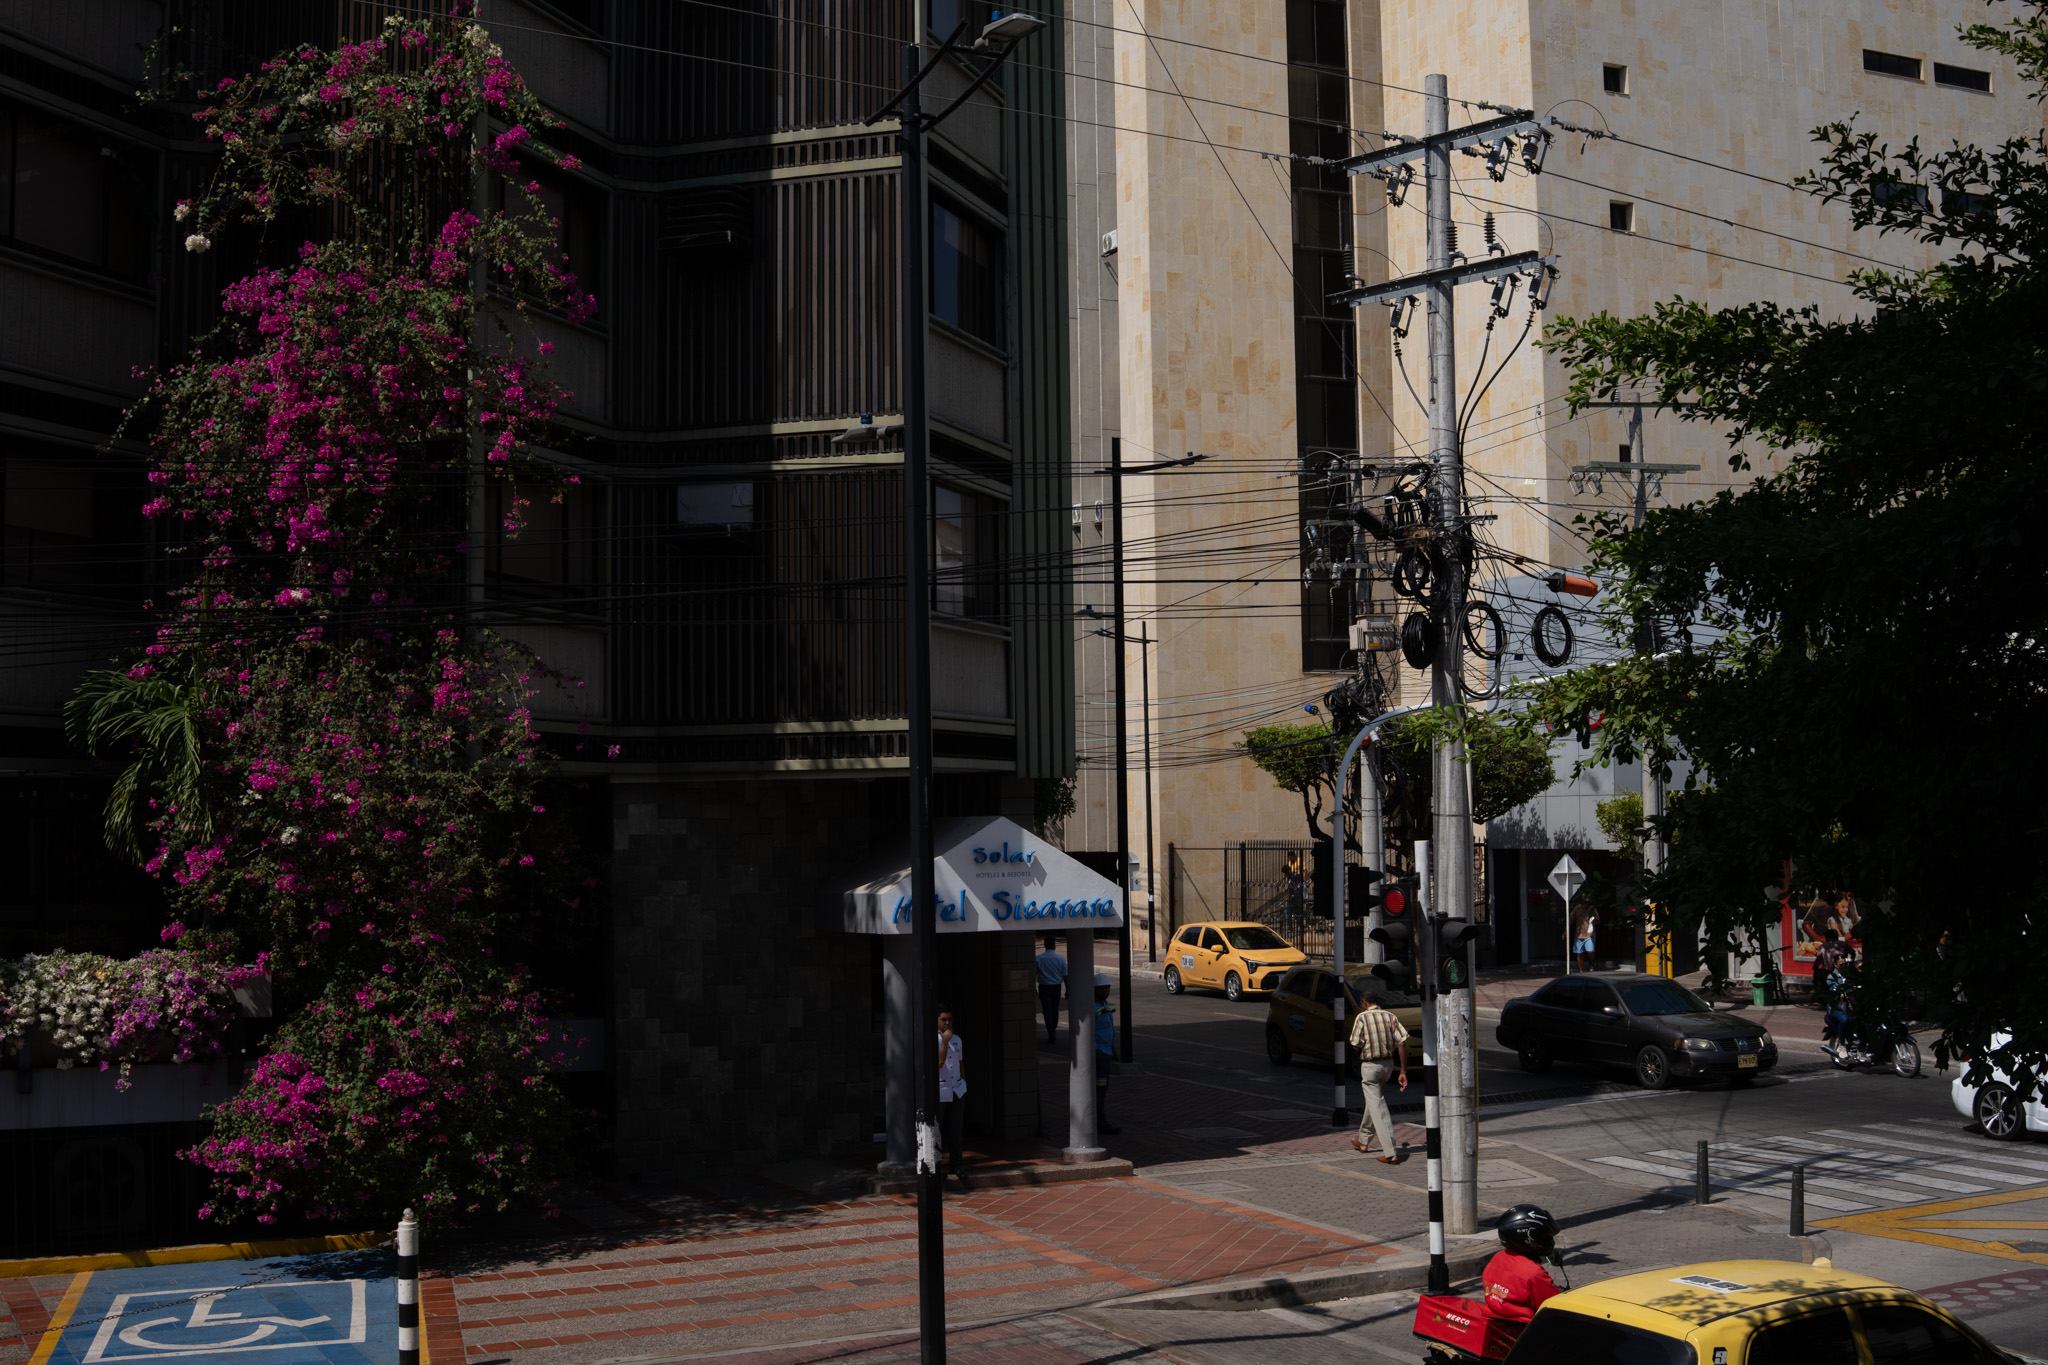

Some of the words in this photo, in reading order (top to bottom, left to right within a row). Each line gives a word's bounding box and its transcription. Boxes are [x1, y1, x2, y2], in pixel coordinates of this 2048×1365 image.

[893, 889, 966, 924] Htel
[992, 891, 1116, 921] Sicarare
[1445, 1313, 1471, 1326] NERCO
